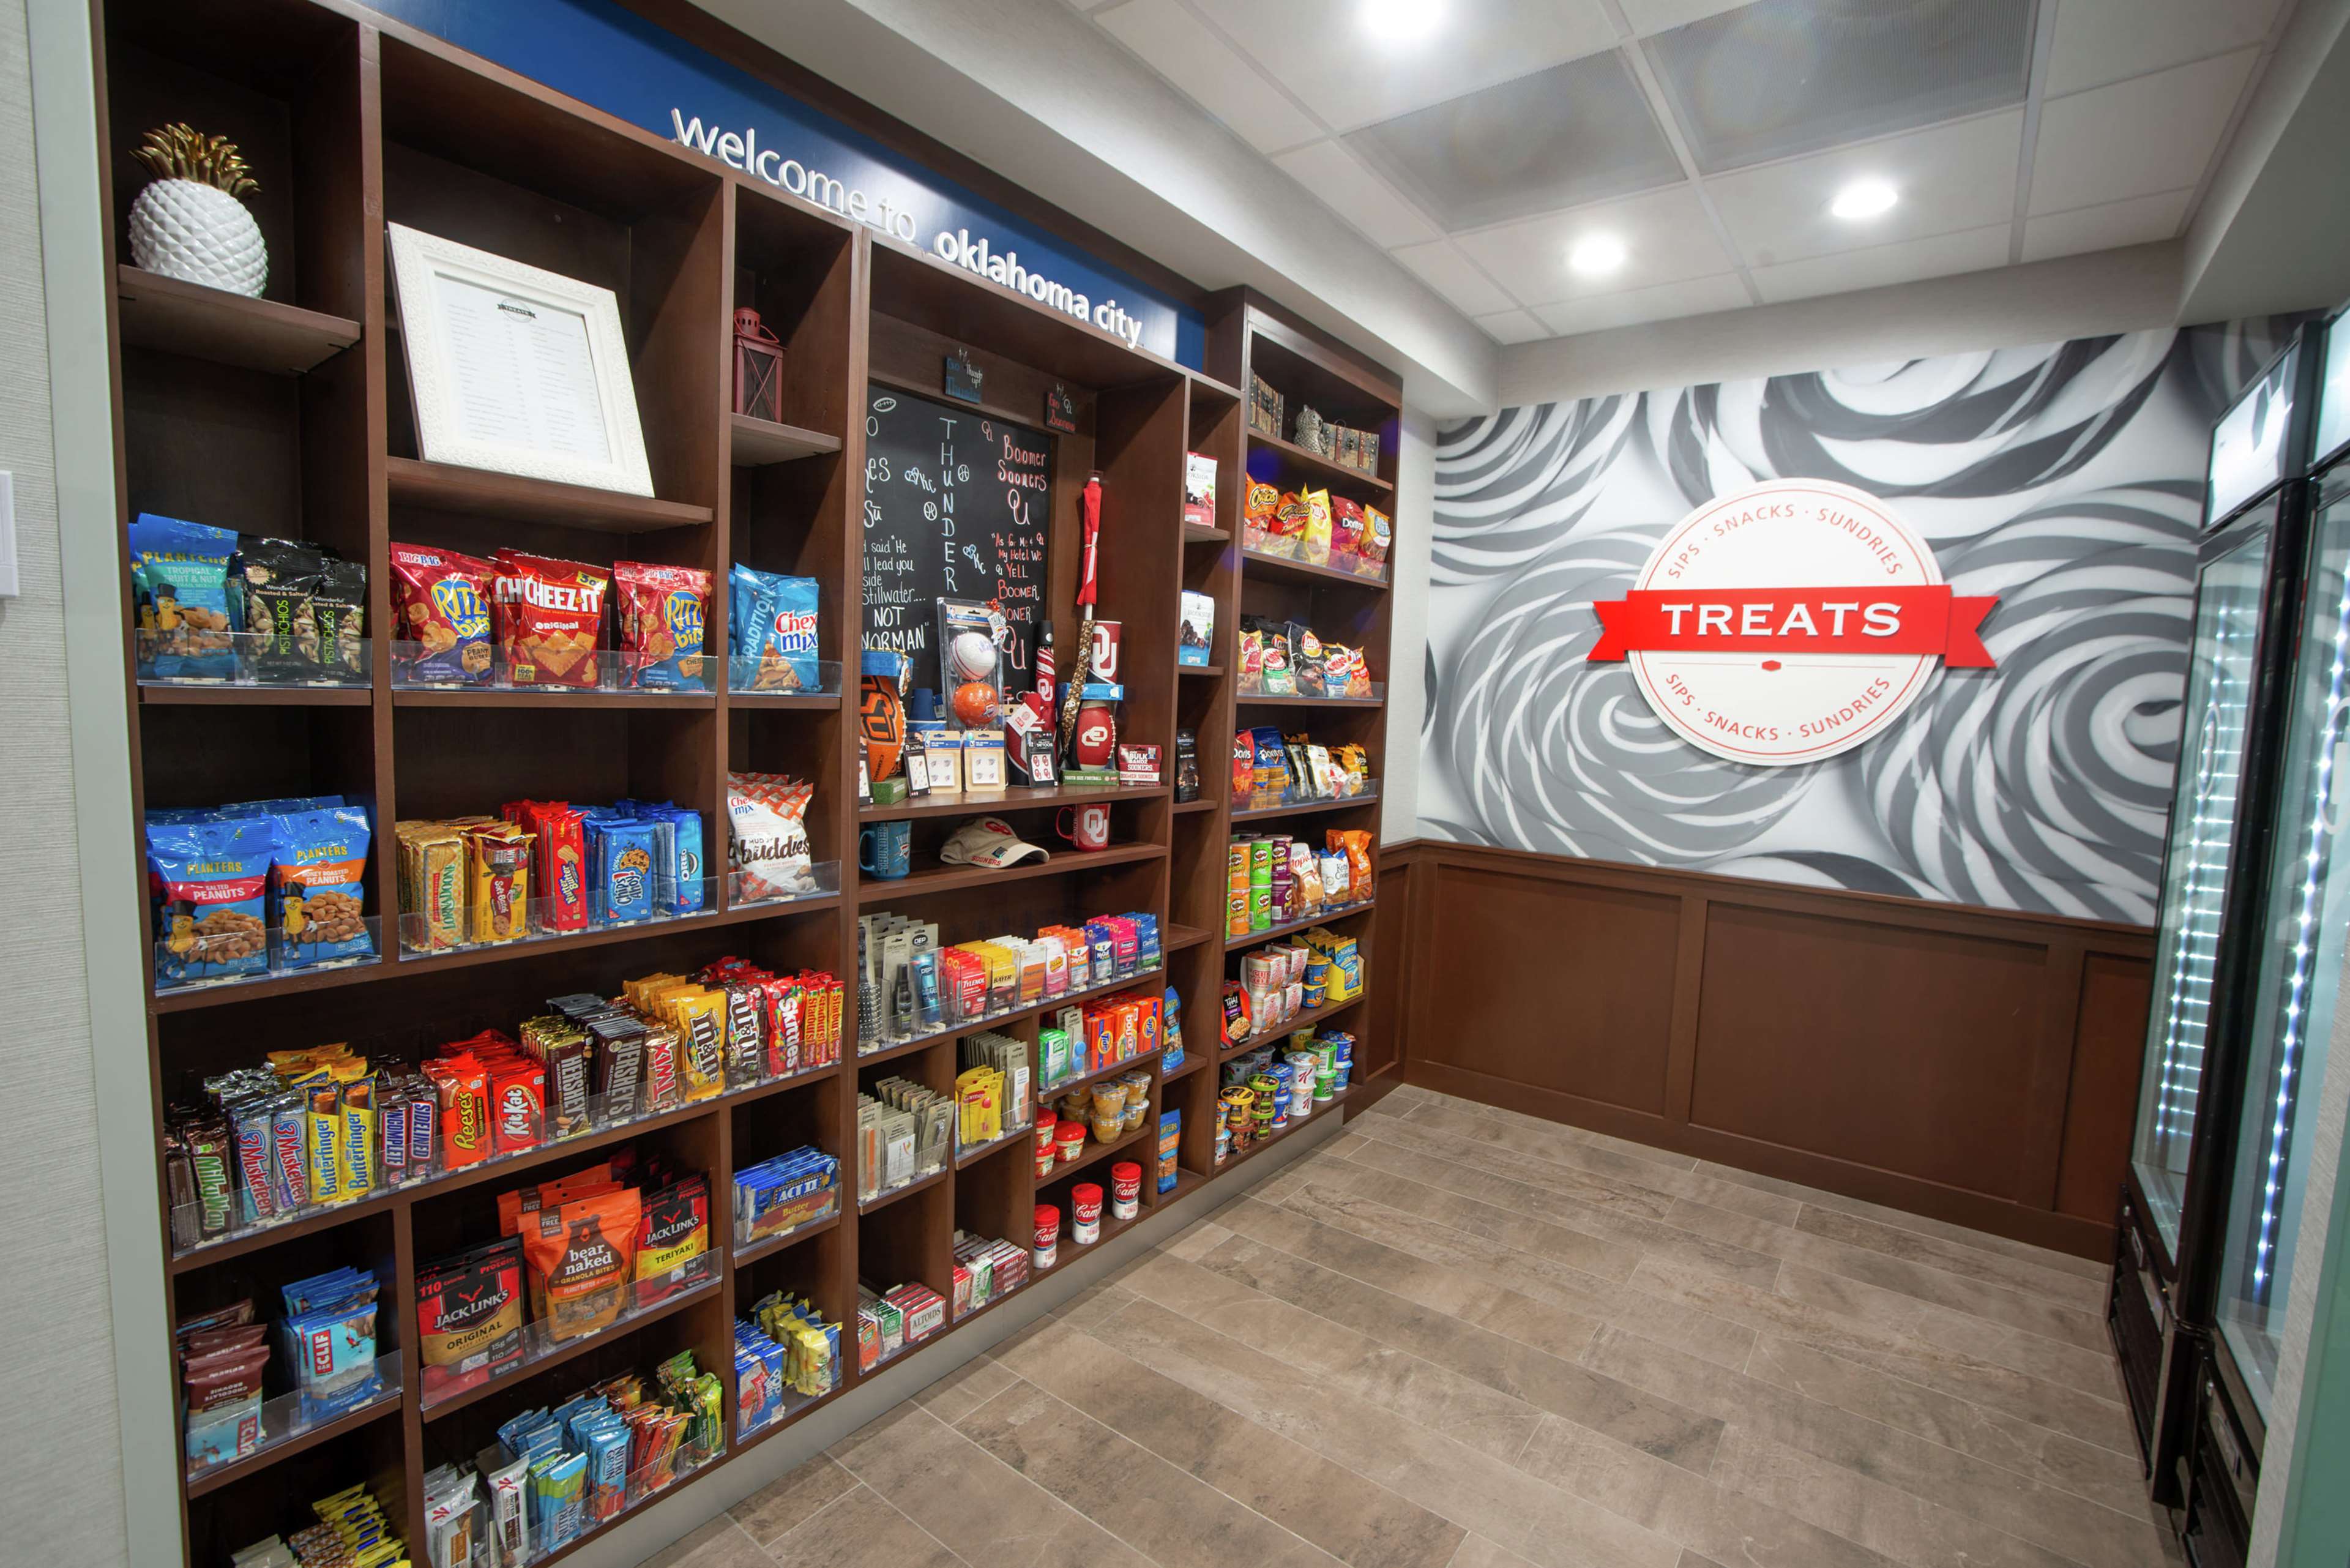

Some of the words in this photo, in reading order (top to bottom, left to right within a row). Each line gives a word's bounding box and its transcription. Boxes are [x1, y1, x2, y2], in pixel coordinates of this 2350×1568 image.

[671, 108, 868, 222] welcome
[878, 196, 917, 242] to
[934, 228, 1089, 321] oklahoma
[1094, 299, 1142, 349] city
[1003, 434, 1046, 466] Boomer
[998, 459, 1047, 491] Sooners
[871, 539, 890, 553] said
[1668, 543, 1701, 579] SIPS
[1712, 504, 1796, 537] SNACKS
[1816, 507, 1903, 576] SUNDRIES
[398, 551, 420, 563] BIG
[420, 554, 441, 566] BAG
[1010, 549, 1029, 561] Hotel
[644, 568, 658, 577] BIG
[658, 570, 673, 578] BAG
[874, 558, 893, 572] lead
[896, 559, 915, 577] you
[434, 584, 489, 617] RITZ
[998, 579, 1040, 601] BOOMER
[666, 595, 703, 630] RITZ
[775, 610, 818, 633] Chex
[874, 606, 905, 627] NOT
[1661, 601, 1903, 638] TREATS
[278, 599, 289, 655] PISTACHIOS
[324, 610, 334, 665] PISTACHIOS
[453, 617, 490, 637] bits
[675, 626, 703, 649] bits
[781, 631, 818, 652] mix
[1665, 673, 1696, 707] SIPS
[1703, 710, 1780, 741] SNACKS
[1799, 676, 1891, 738] SUNDRIES
[734, 805, 753, 815] mix
[296, 846, 348, 860] PLANTERS
[739, 834, 810, 864] buddies
[186, 861, 242, 876] PLANTERS
[680, 848, 690, 881] OREO
[971, 855, 1002, 867] SOONERS
[307, 875, 345, 885] PEANUTS
[193, 887, 245, 900] PEANUTS
[616, 879, 632, 905] Chips
[963, 977, 985, 988] TYLENOL
[778, 998, 799, 1068] Skittles
[608, 1040, 642, 1116] HERSHEY'S
[652, 1042, 675, 1102] TWIX
[561, 1055, 586, 1125] HERSHEY'S
[275, 1122, 295, 1138] 3
[411, 1103, 432, 1158] SIDELINED
[453, 1091, 477, 1150] Reese's
[238, 1132, 260, 1148] 3
[348, 1111, 367, 1190] Butterfinger
[319, 1119, 337, 1196] Butterfinger
[240, 1145, 272, 1217] Musketeers
[277, 1138, 307, 1206] Musketeers
[778, 1184, 805, 1202] ACT
[805, 1179, 818, 1192] II
[783, 1202, 808, 1217] Butter
[542, 1219, 559, 1228] FREE
[645, 1228, 671, 1245] JACK
[565, 1251, 613, 1275] naked
[570, 1244, 605, 1263] bear
[655, 1242, 694, 1264] TERIYAKI
[480, 1256, 516, 1274] Protein
[561, 1272, 594, 1284] GRANOLA
[595, 1266, 615, 1275] BITES
[419, 1281, 442, 1297] 110
[434, 1306, 470, 1328] JACK
[912, 1306, 941, 1329] ALTOIDS
[447, 1321, 503, 1350] ORIGINAL
[315, 1333, 330, 1365] CLIF
[615, 1446, 625, 1476] NUTRI
[559, 1509, 567, 1539] NUTRI
